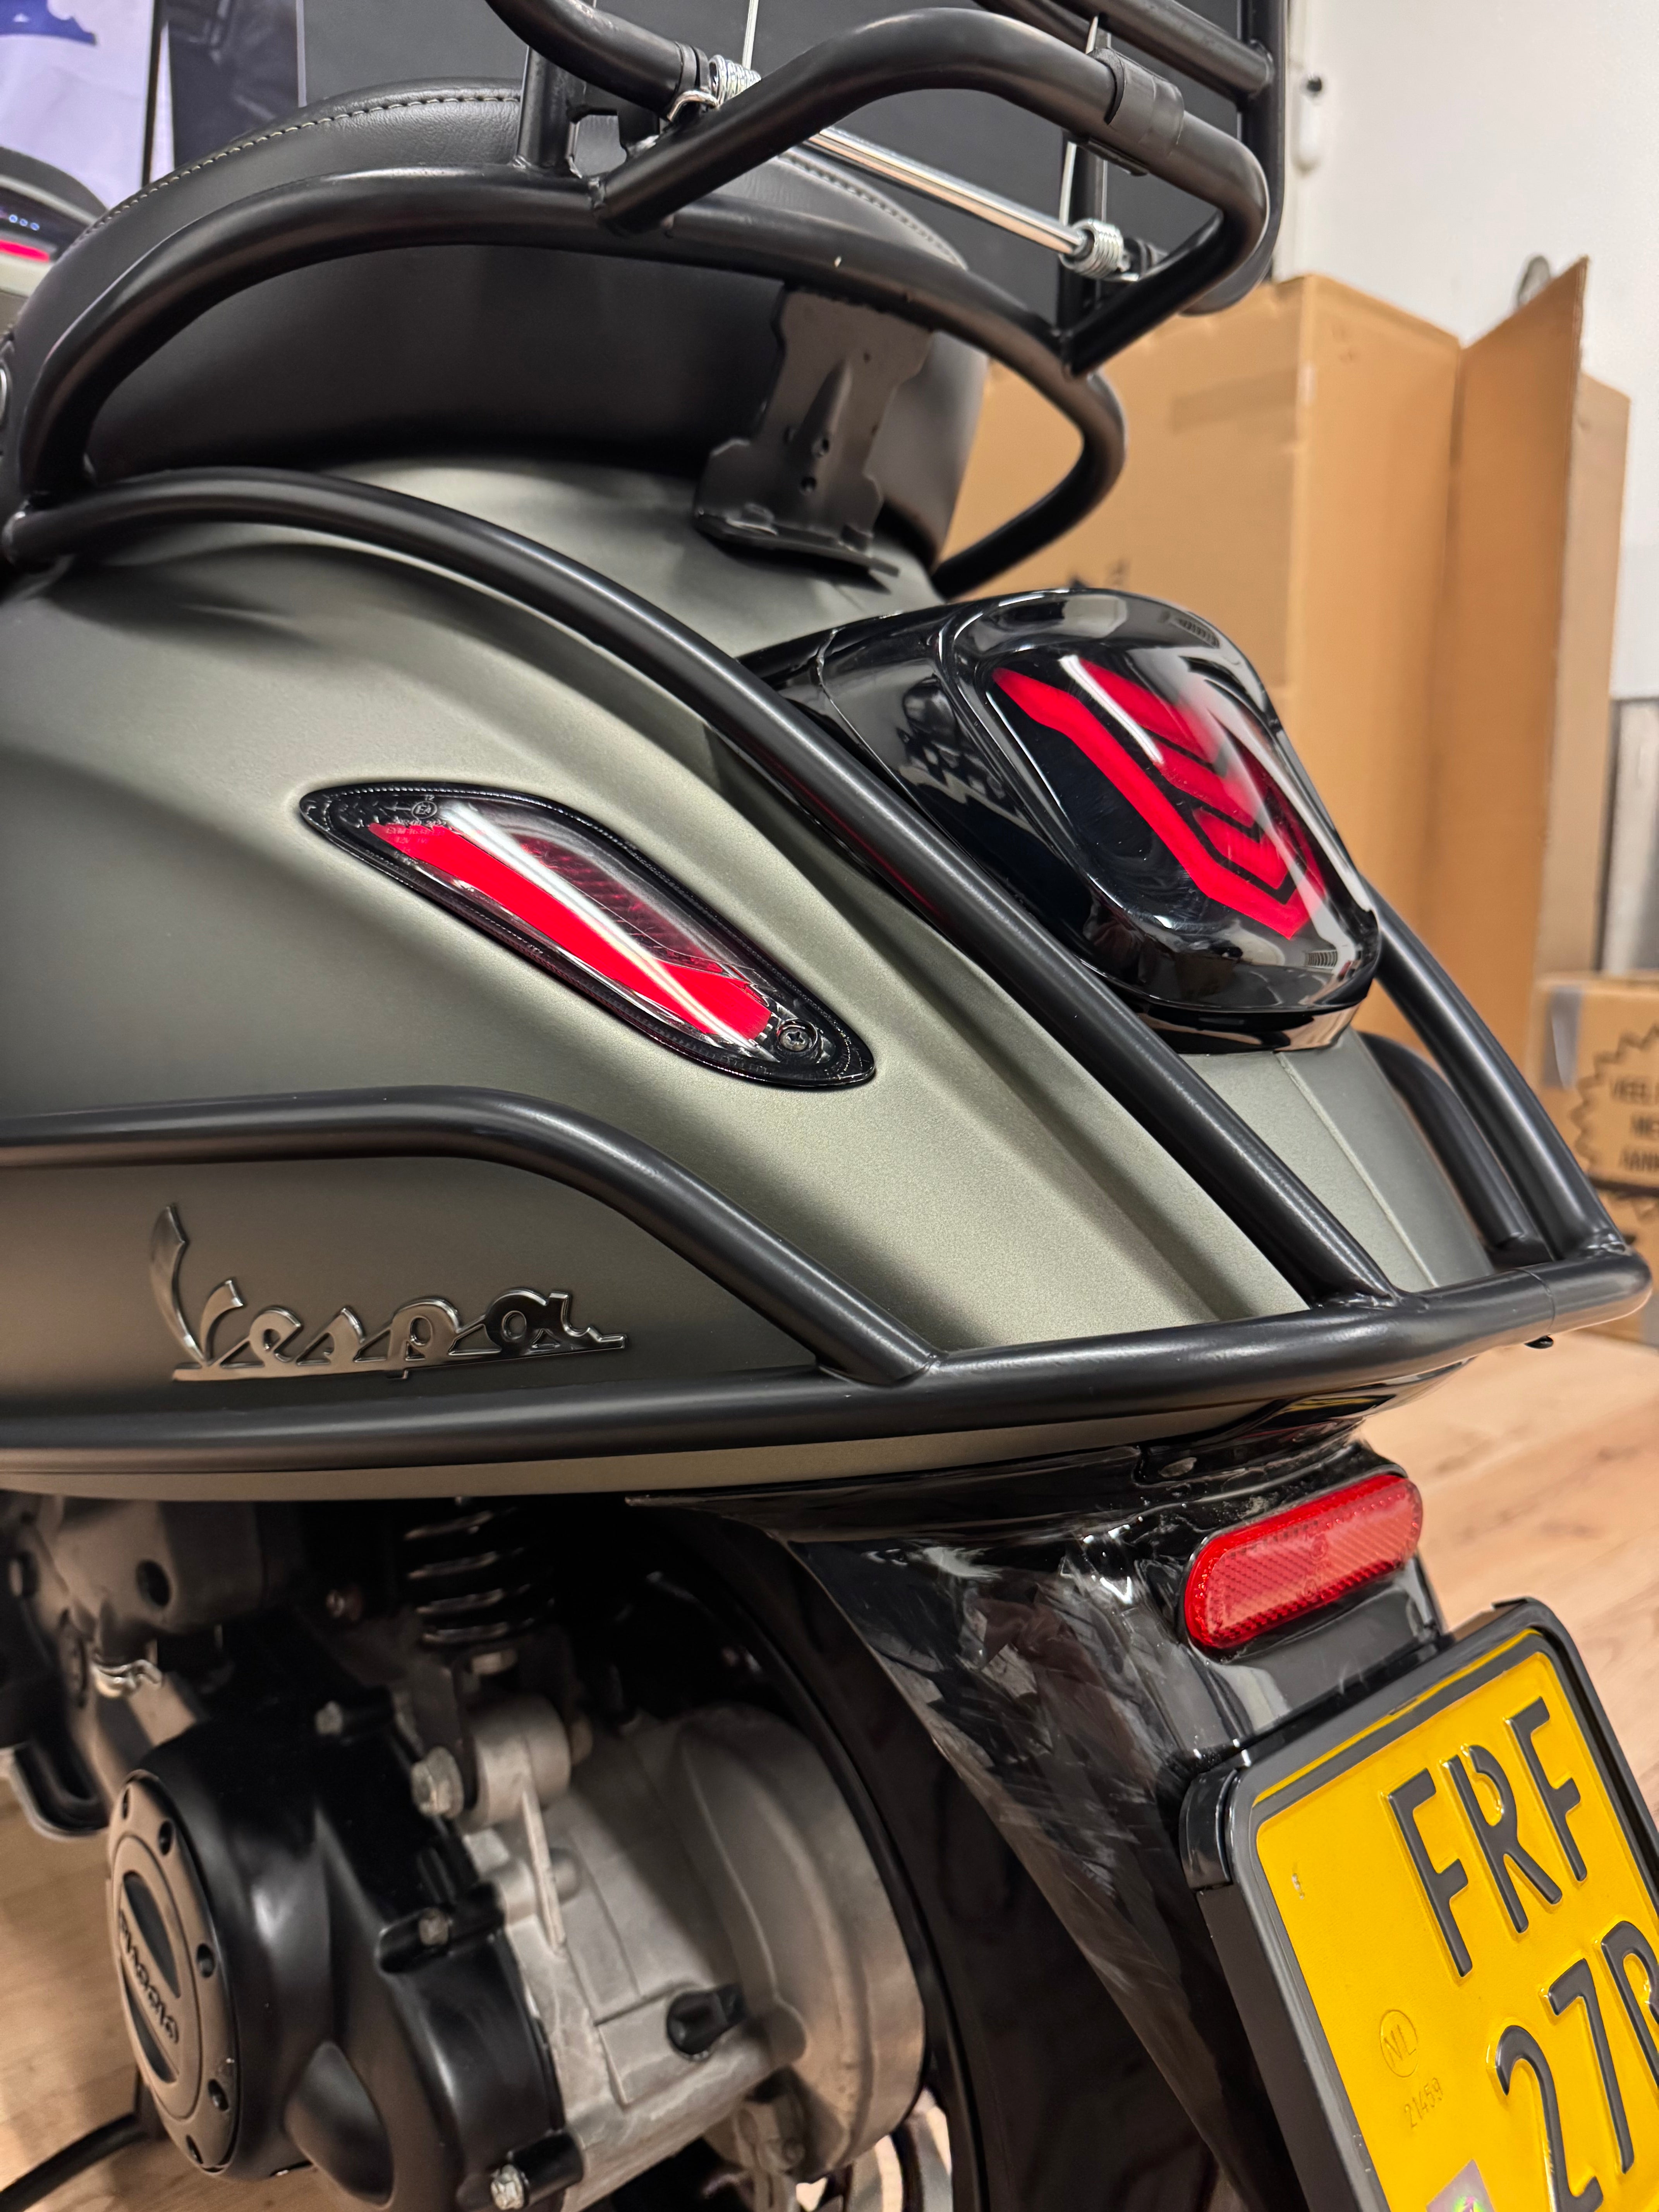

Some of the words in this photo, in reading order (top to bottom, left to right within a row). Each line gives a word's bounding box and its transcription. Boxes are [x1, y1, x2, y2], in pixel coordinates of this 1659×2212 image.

[149, 1202, 629, 1382] Vespa
[1388, 1696, 1587, 1978] FRF
[1383, 2023, 1417, 2069] NL
[1404, 2076, 1443, 2128] 21459
